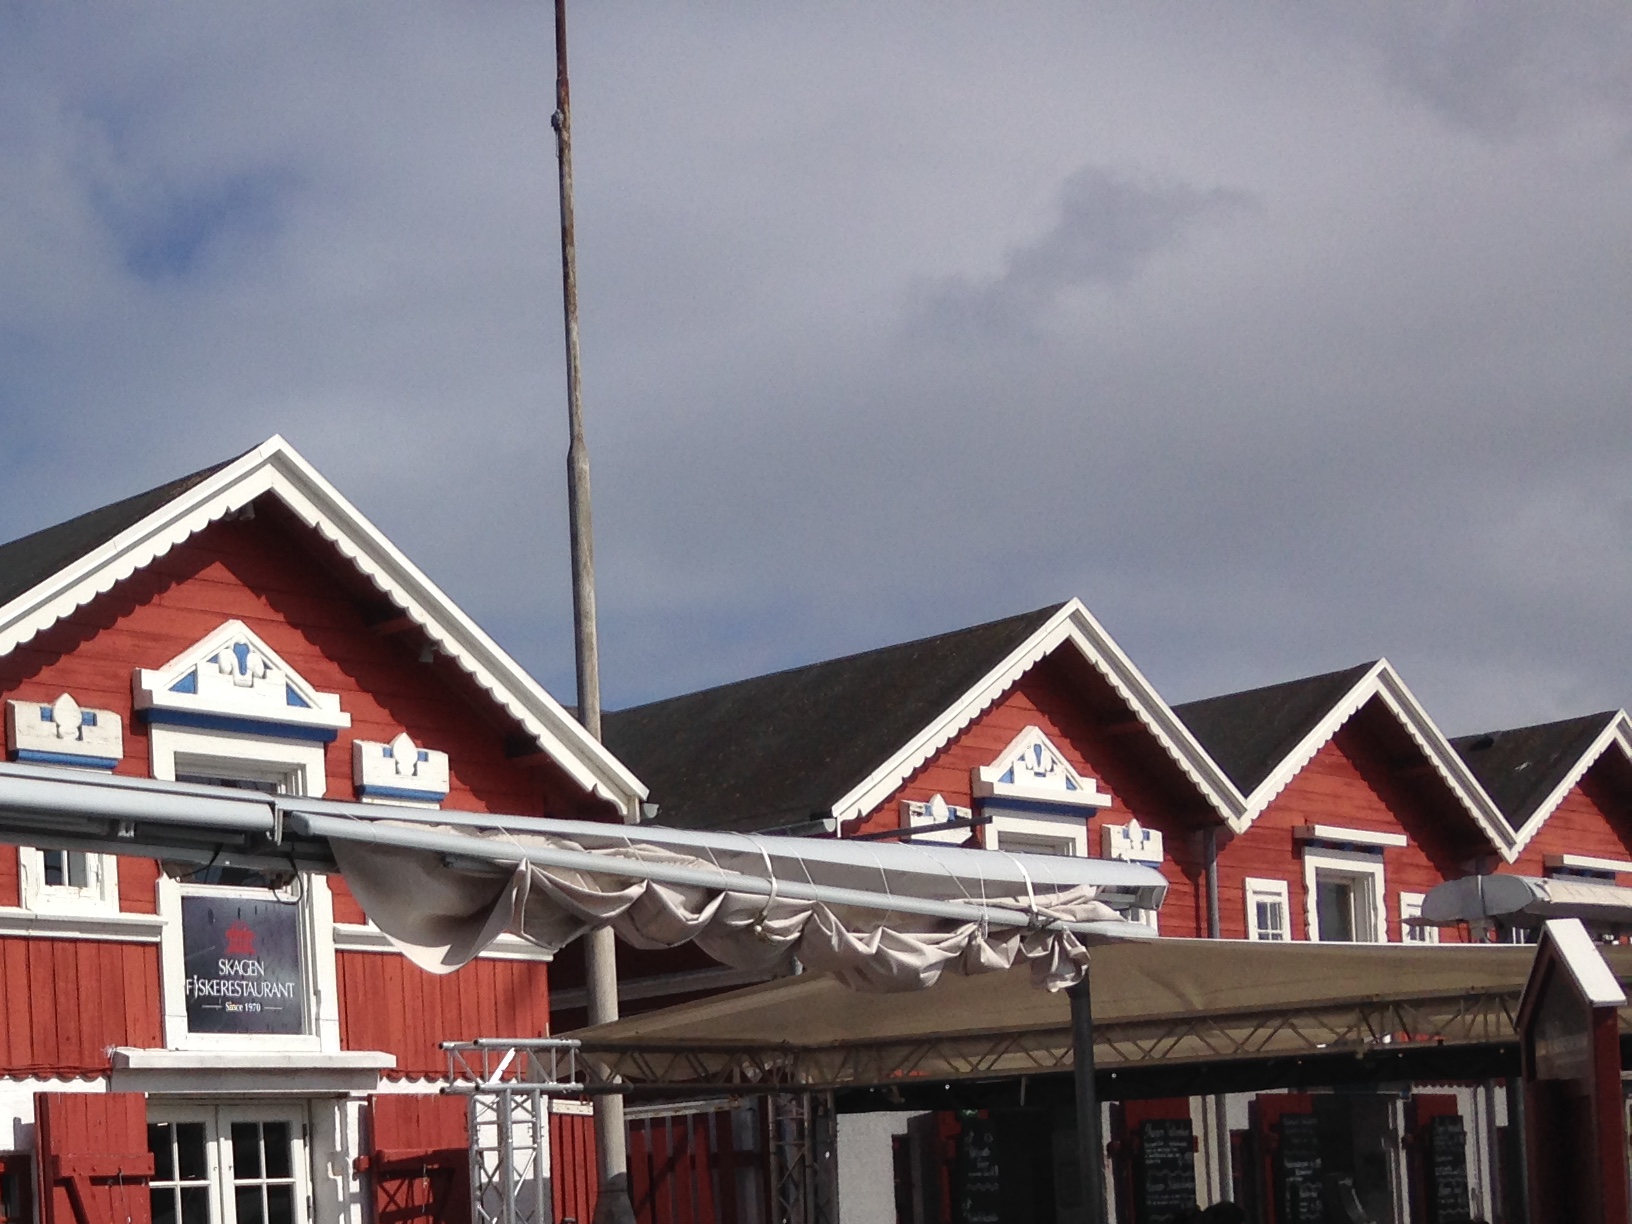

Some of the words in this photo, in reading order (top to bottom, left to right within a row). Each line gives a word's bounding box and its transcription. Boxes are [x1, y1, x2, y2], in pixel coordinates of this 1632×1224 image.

[218, 959, 265, 976] SKAGEN
[186, 975, 295, 998] FISKERESTAURANT
[225, 1001, 243, 1012] Since
